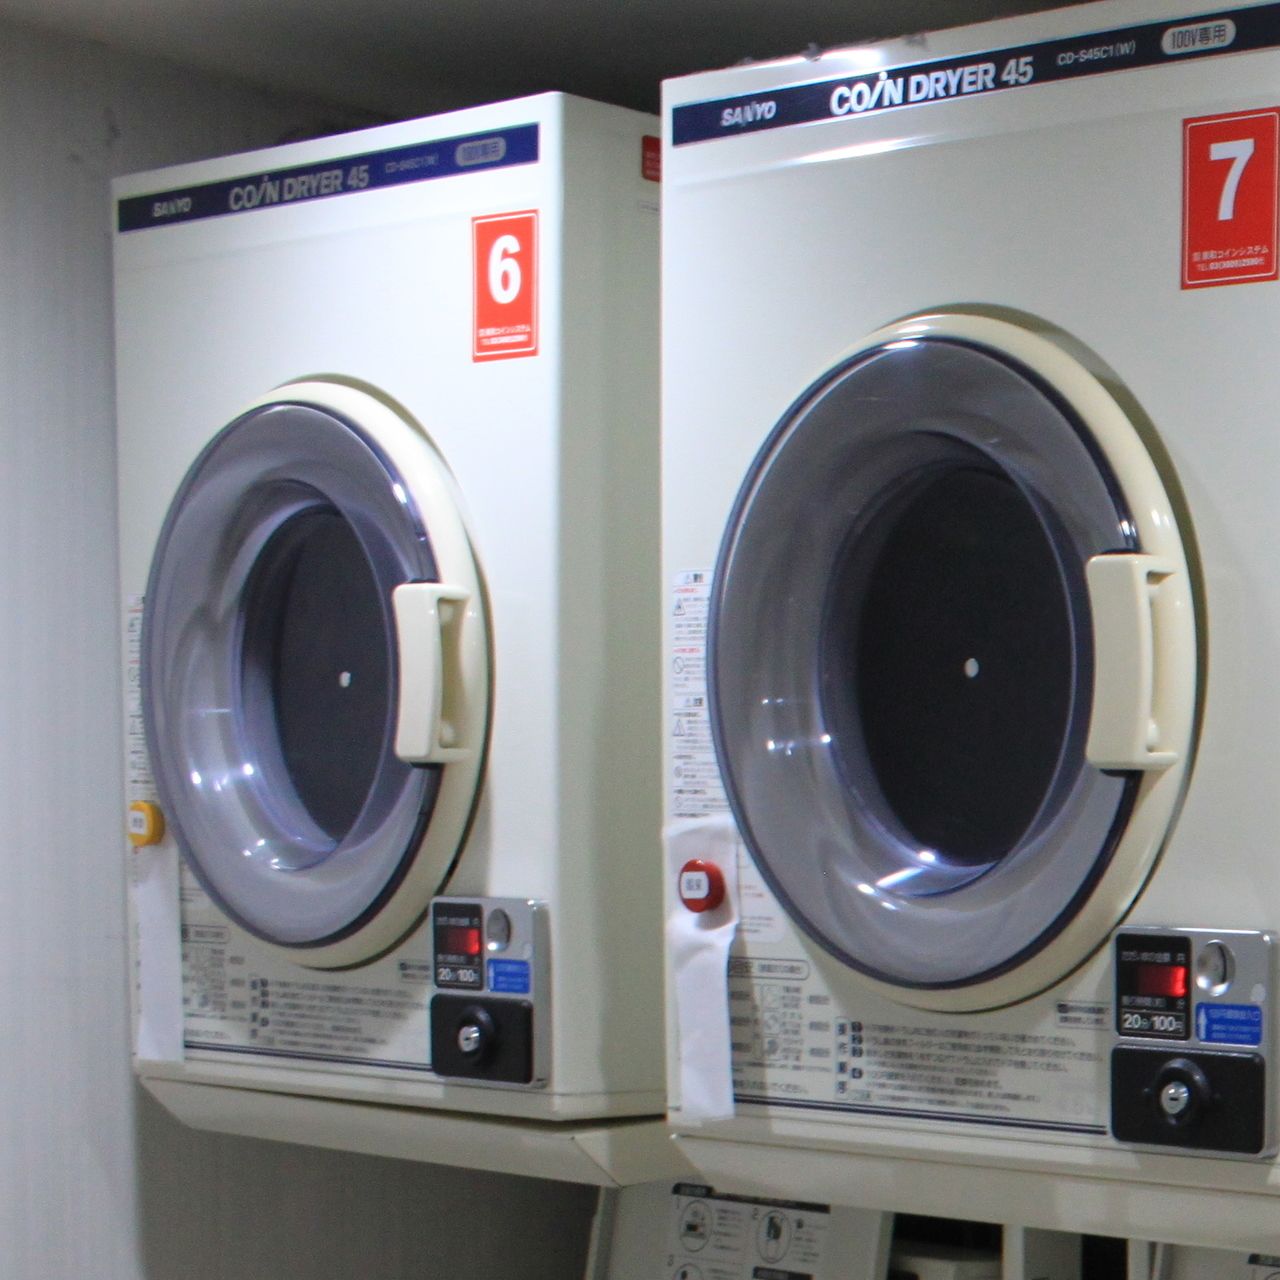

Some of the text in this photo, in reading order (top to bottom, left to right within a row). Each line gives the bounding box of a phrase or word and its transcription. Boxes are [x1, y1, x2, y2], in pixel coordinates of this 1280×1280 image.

[1169, 24, 1228, 50] 100V専用
[720, 101, 776, 127] SANYO
[908, 63, 995, 102] DRYER
[1001, 56, 1034, 85] 45
[152, 197, 192, 218] SANYO
[284, 168, 344, 201] DRYER
[346, 164, 370, 189] 45
[1209, 138, 1255, 221] 7
[488, 234, 522, 304] 6
